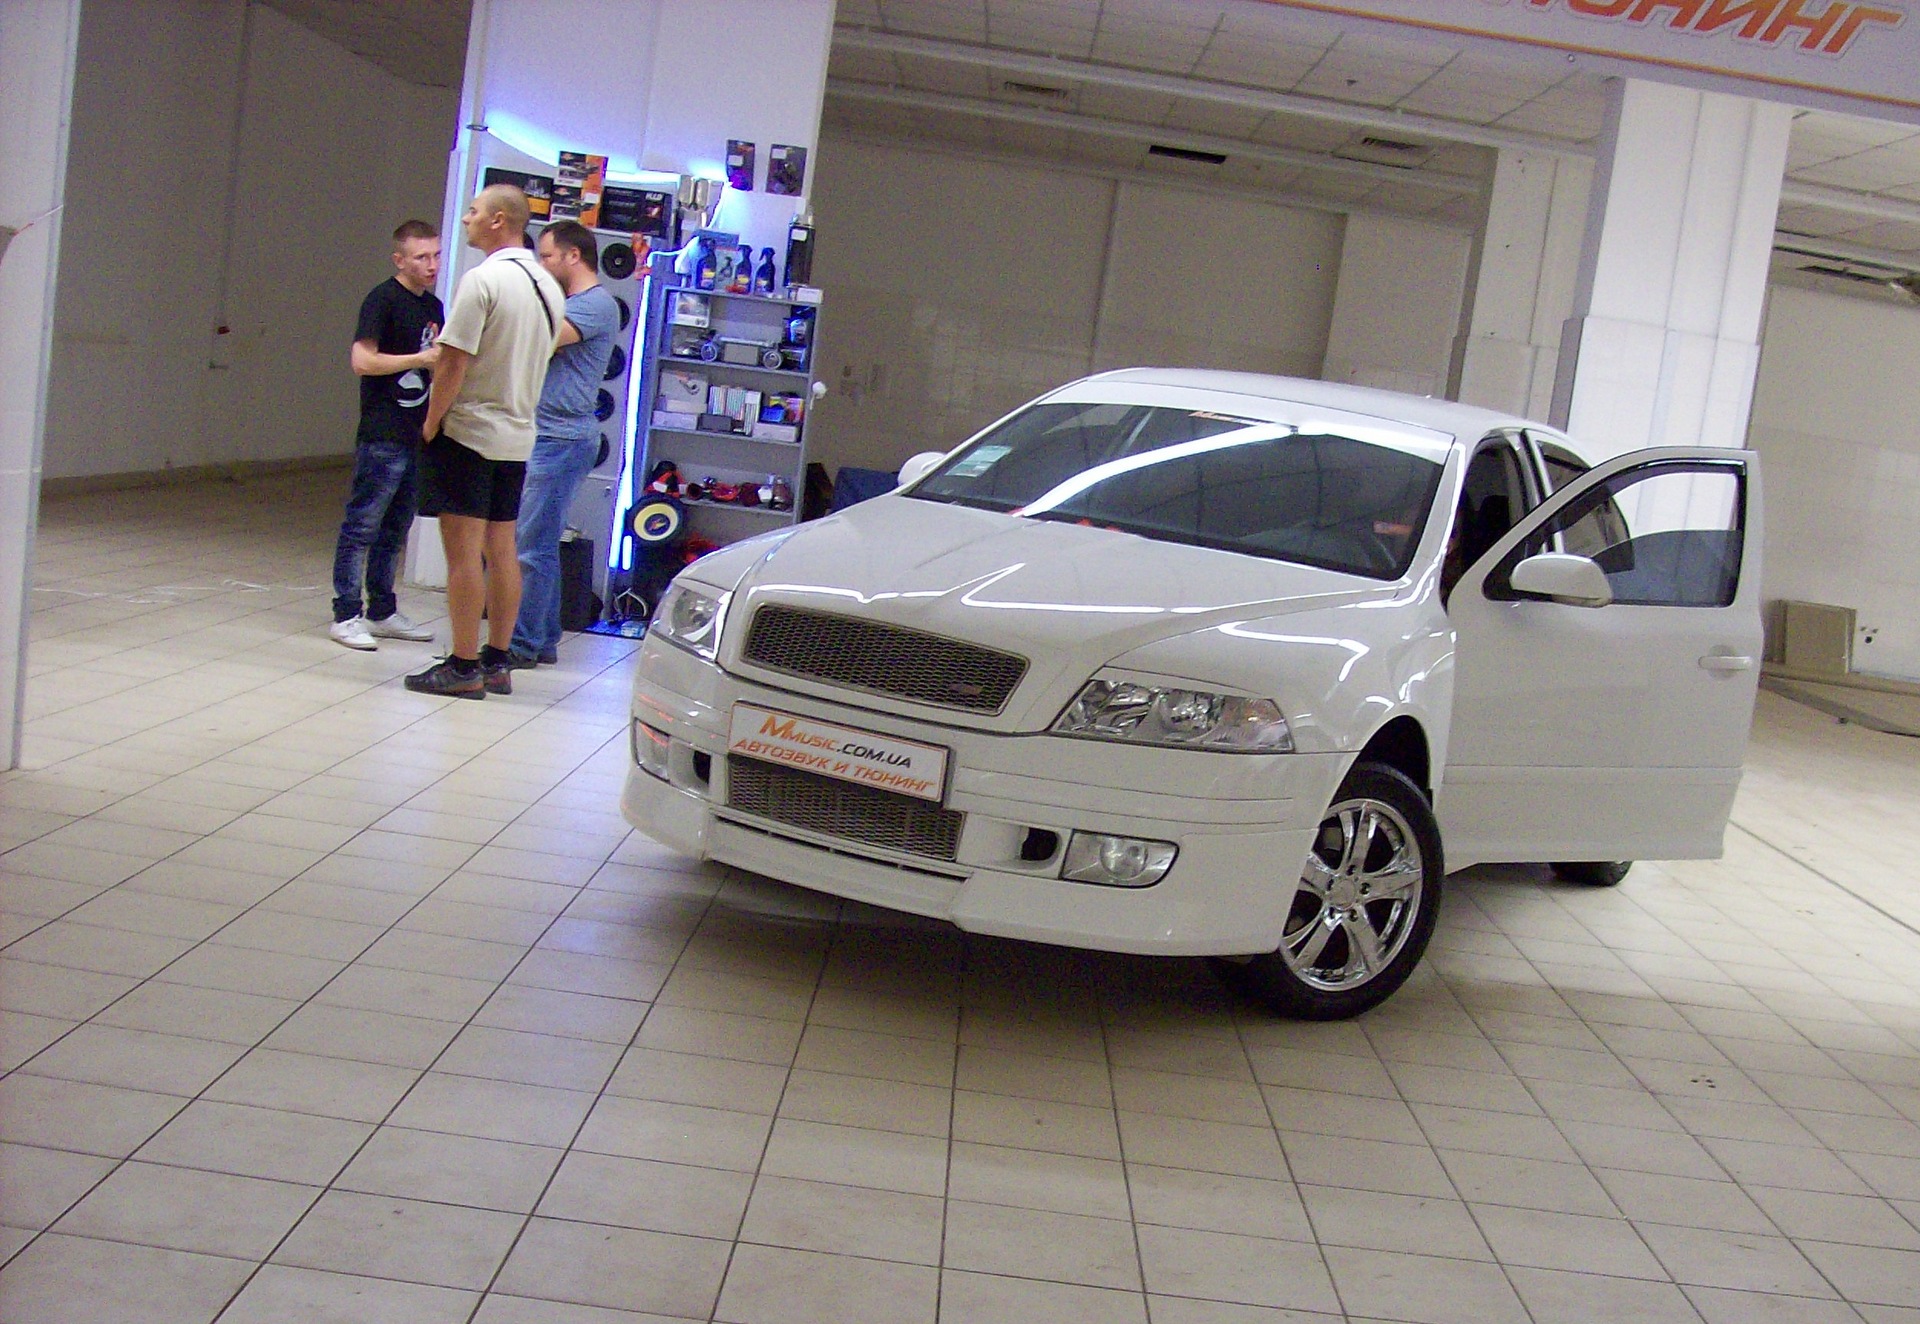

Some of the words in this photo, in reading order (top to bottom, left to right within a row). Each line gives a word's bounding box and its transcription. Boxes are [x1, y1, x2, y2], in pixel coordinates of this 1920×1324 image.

[734, 738, 829, 770] АВТОЗВУК
[833, 761, 848, 774] И
[854, 765, 936, 792] ТЮНИНГ
